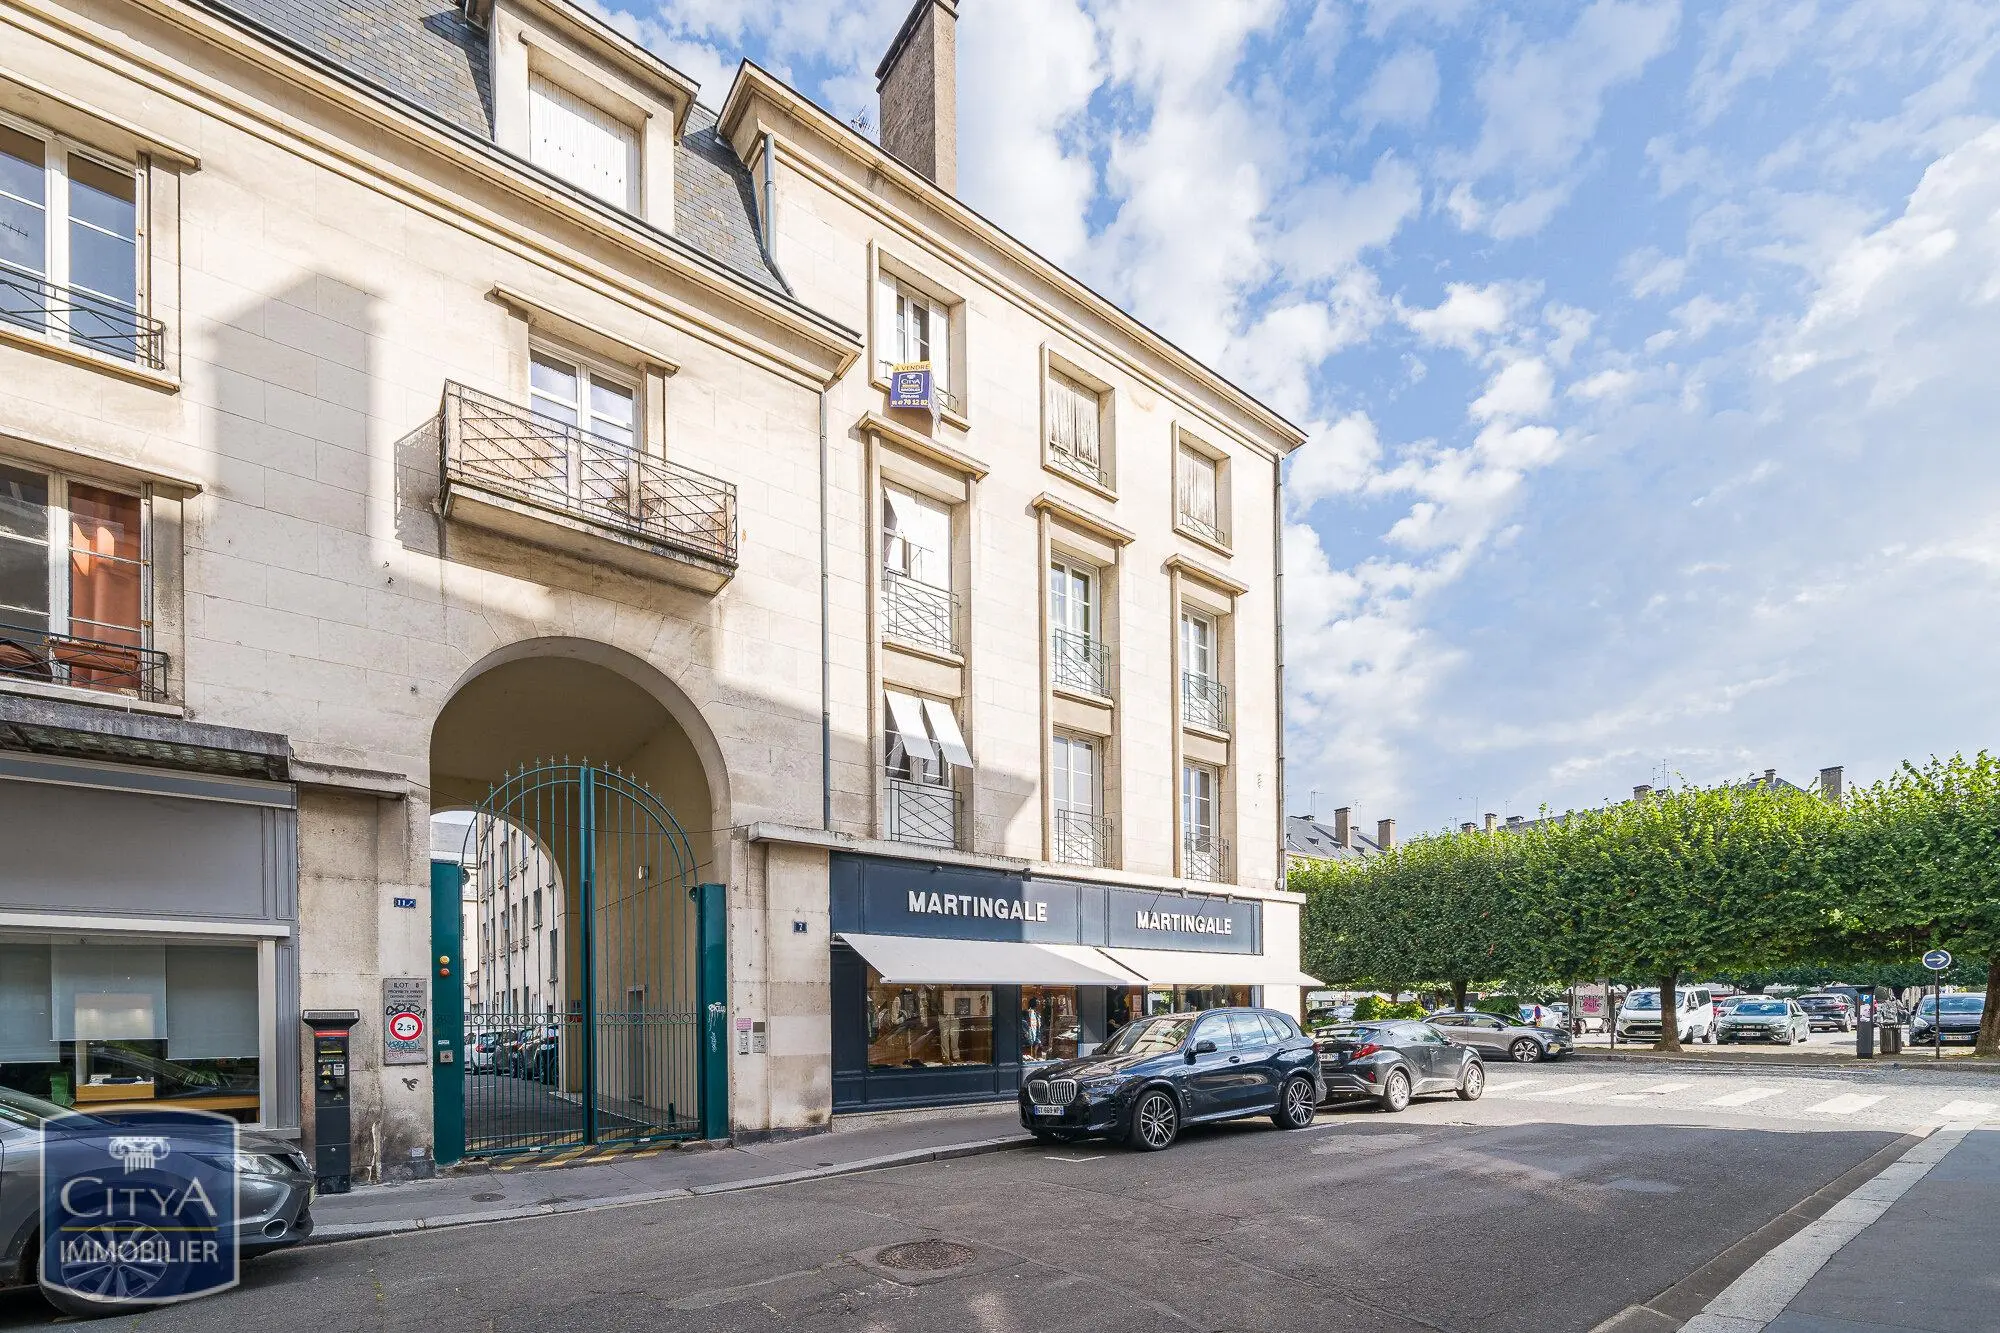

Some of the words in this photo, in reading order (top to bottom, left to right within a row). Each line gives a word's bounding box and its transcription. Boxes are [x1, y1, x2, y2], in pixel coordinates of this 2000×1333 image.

[908, 890, 1048, 923] MARTINGALE
[1136, 910, 1232, 935] MARTINGALE
[1862, 994, 1870, 1002] P
[396, 1022, 416, 1031] 2,5t
